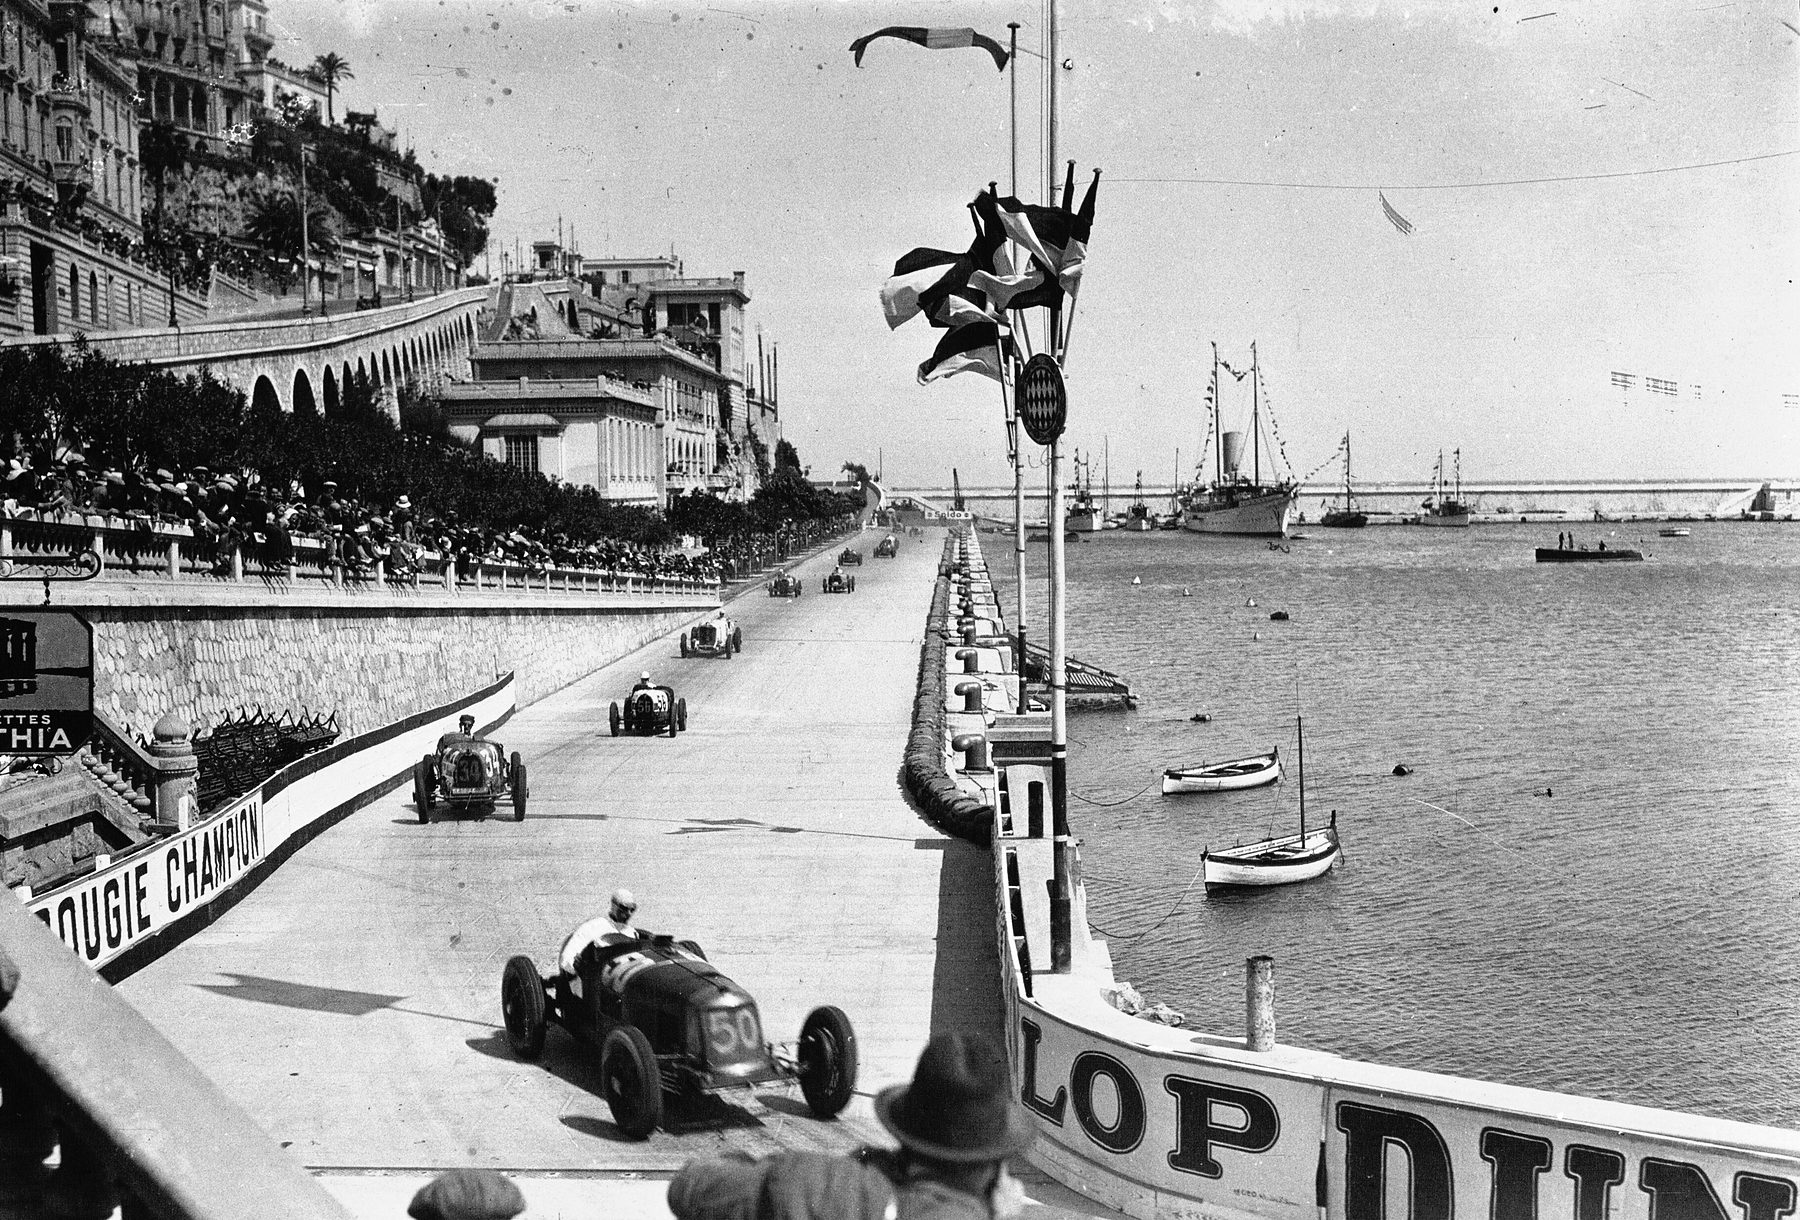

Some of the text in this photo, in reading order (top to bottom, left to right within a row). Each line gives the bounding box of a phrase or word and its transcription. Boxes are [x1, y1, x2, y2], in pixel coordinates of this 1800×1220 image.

[0, 714, 51, 725] TTES
[34, 801, 260, 961] OUGIE CHAMPION
[708, 1007, 760, 1054] 50
[1020, 1016, 1281, 1180] LOP
